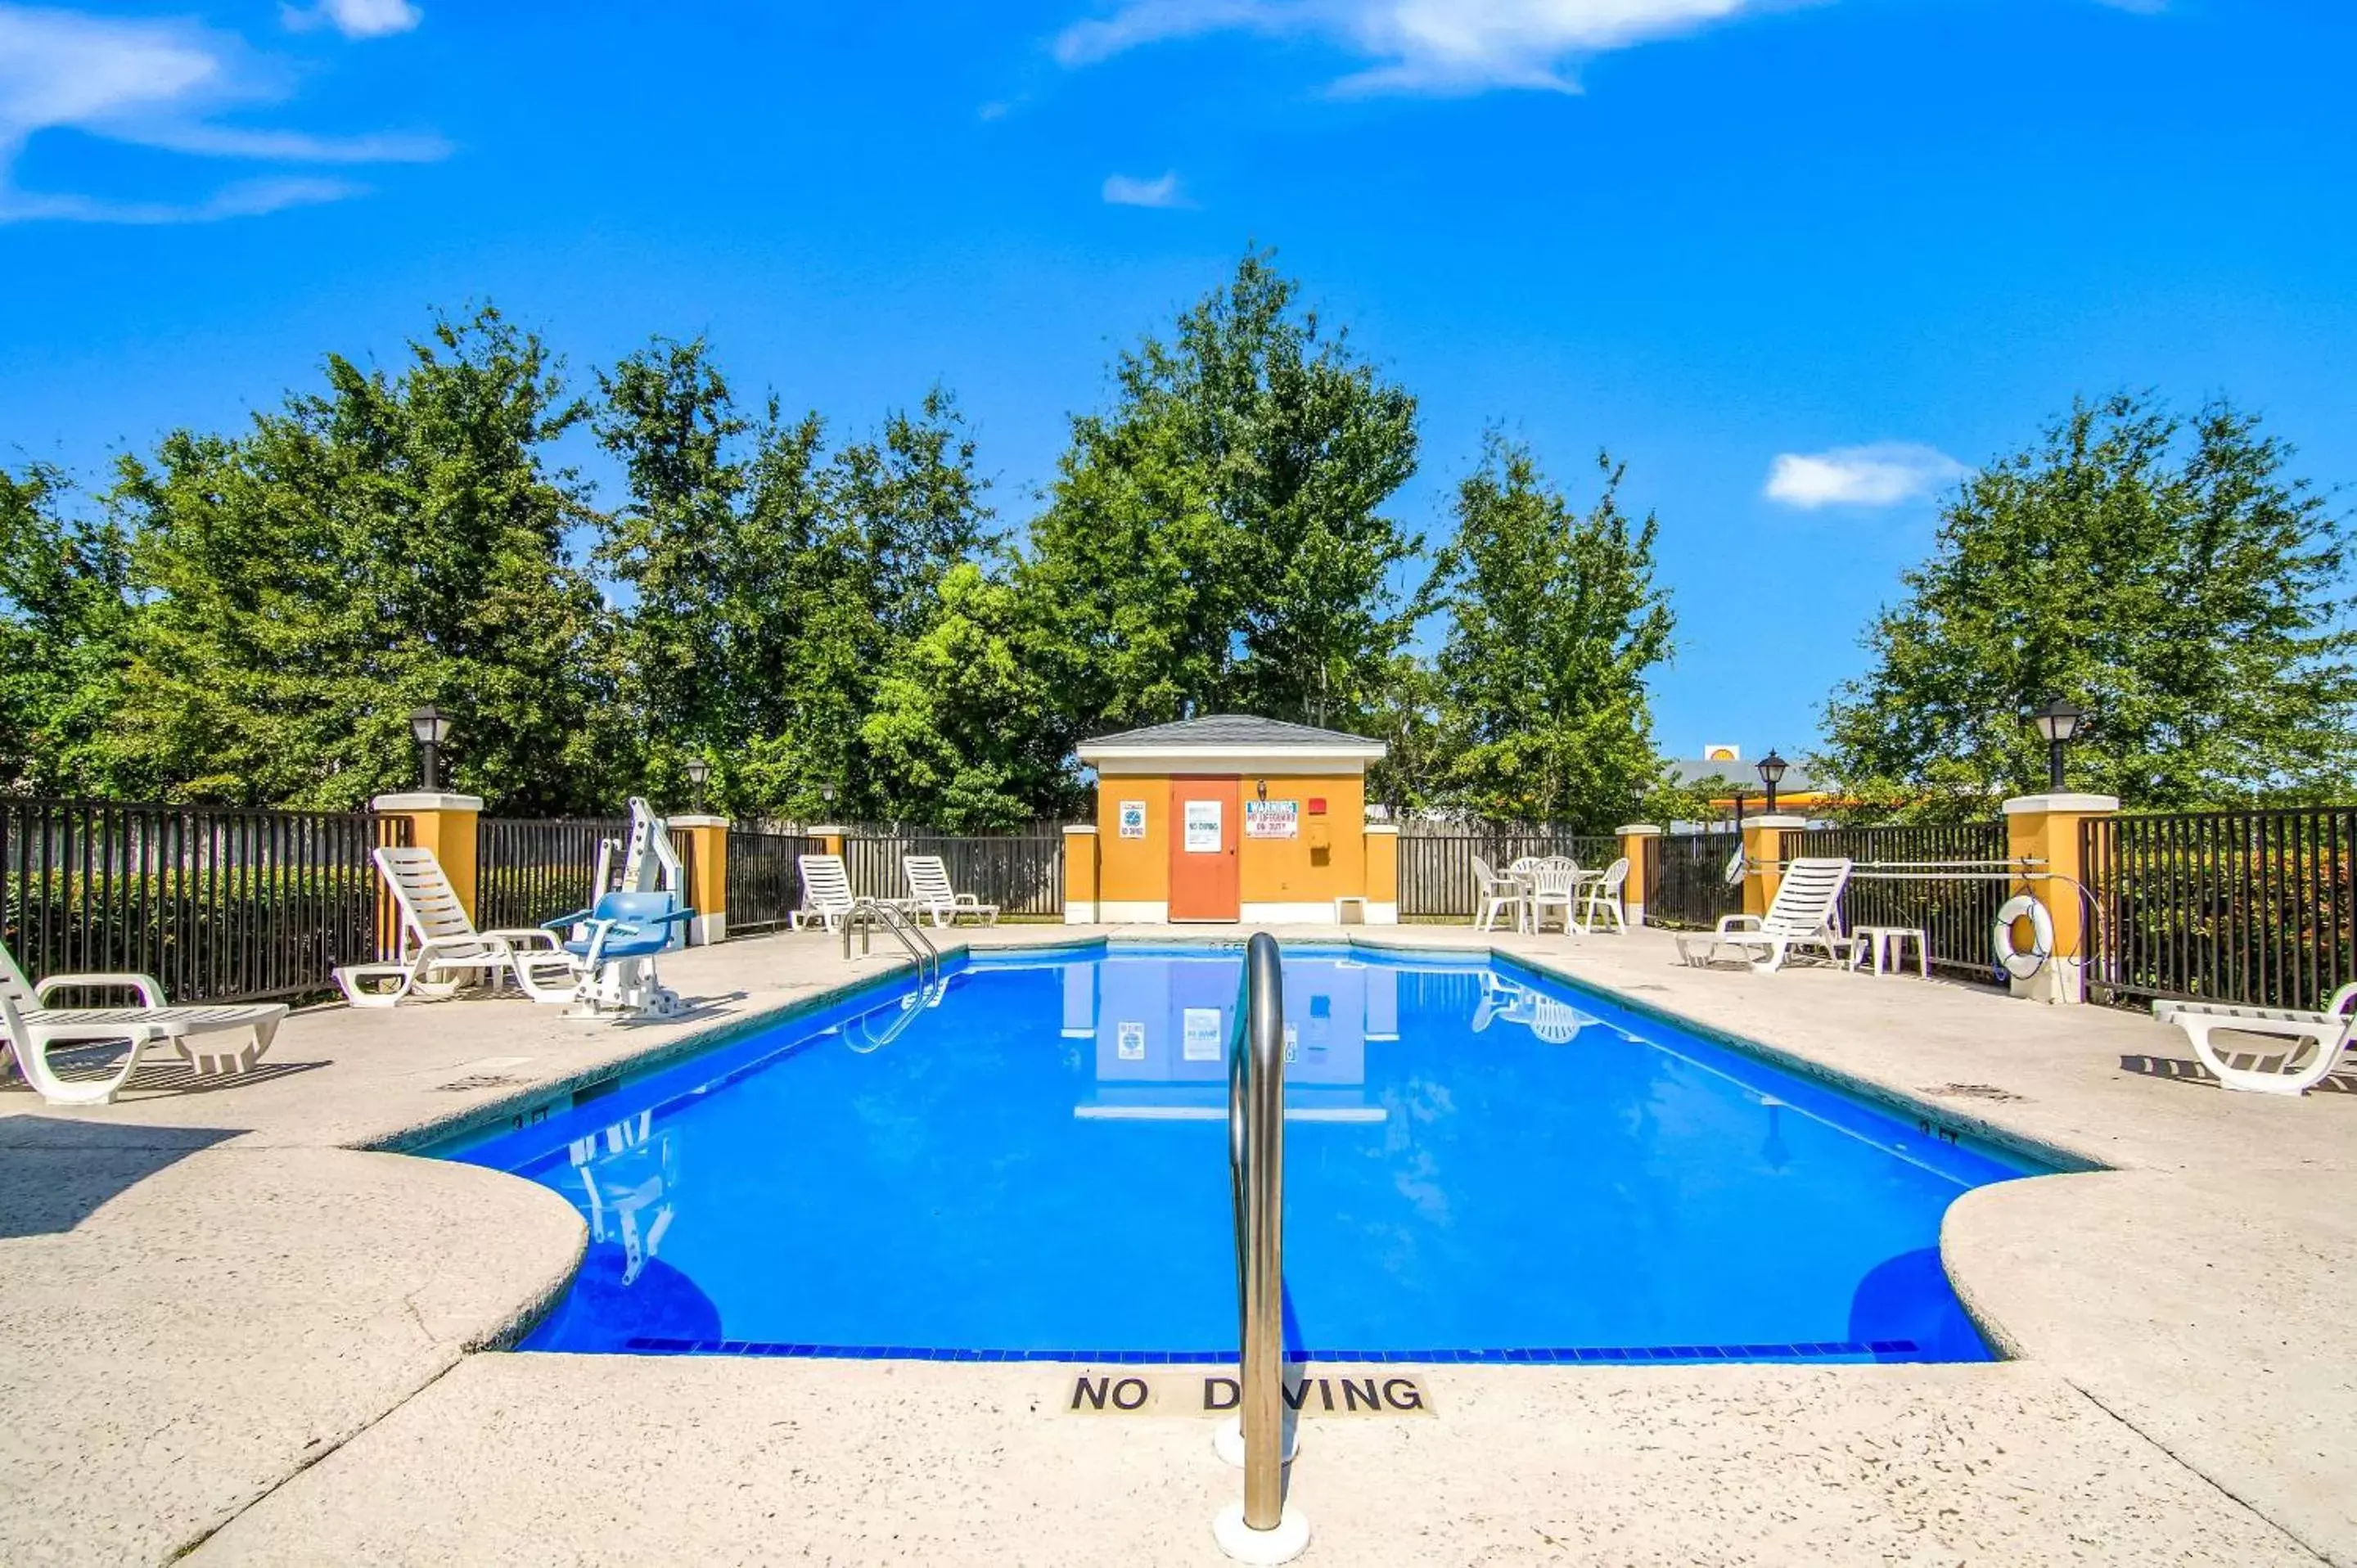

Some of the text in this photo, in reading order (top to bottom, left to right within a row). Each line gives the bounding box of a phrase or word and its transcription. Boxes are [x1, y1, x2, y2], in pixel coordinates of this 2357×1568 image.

[1250, 802, 1293, 813] WARNING
[1071, 1377, 1426, 1411] NO DVING
